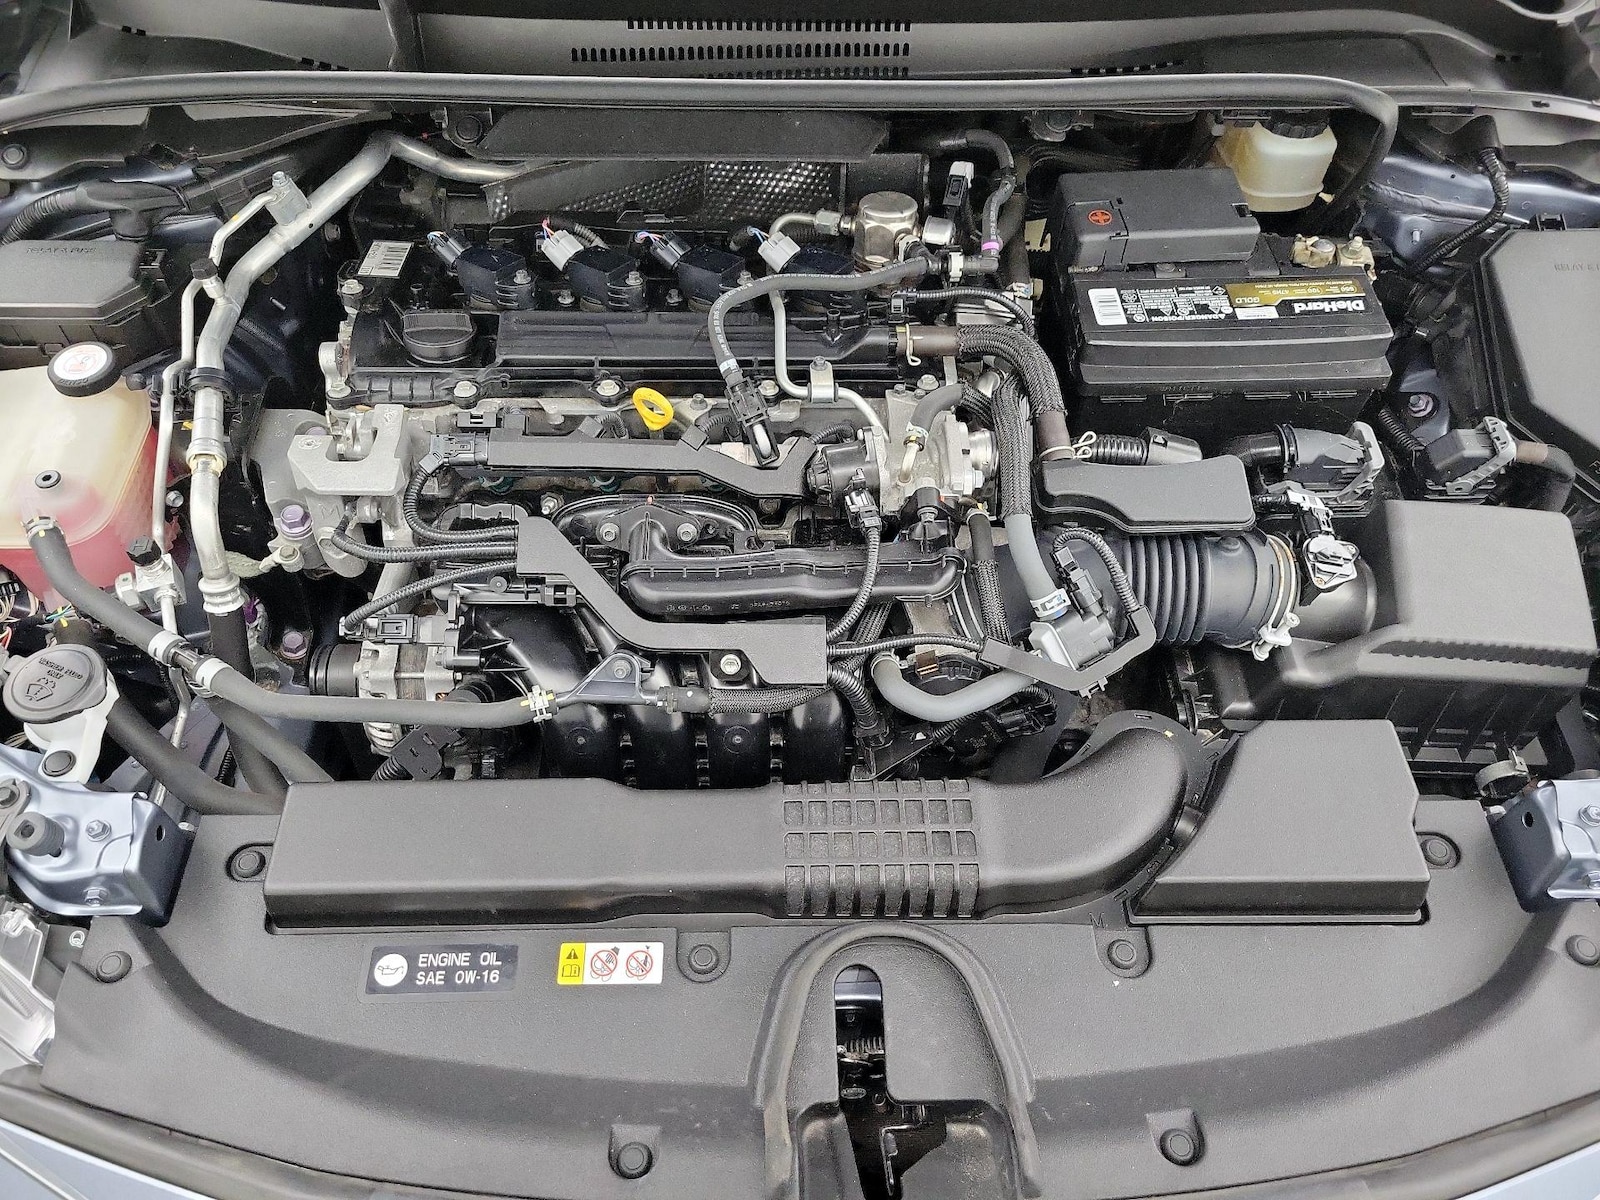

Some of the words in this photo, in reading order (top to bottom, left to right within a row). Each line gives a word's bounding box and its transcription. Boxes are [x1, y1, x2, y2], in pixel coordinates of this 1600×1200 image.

[1293, 300, 1365, 313] DieHard
[39, 657, 64, 672] WASHER
[418, 951, 471, 967] ENGINE
[480, 951, 502, 966] OIL
[415, 970, 445, 985] SAE
[455, 969, 500, 984] 0W-16
